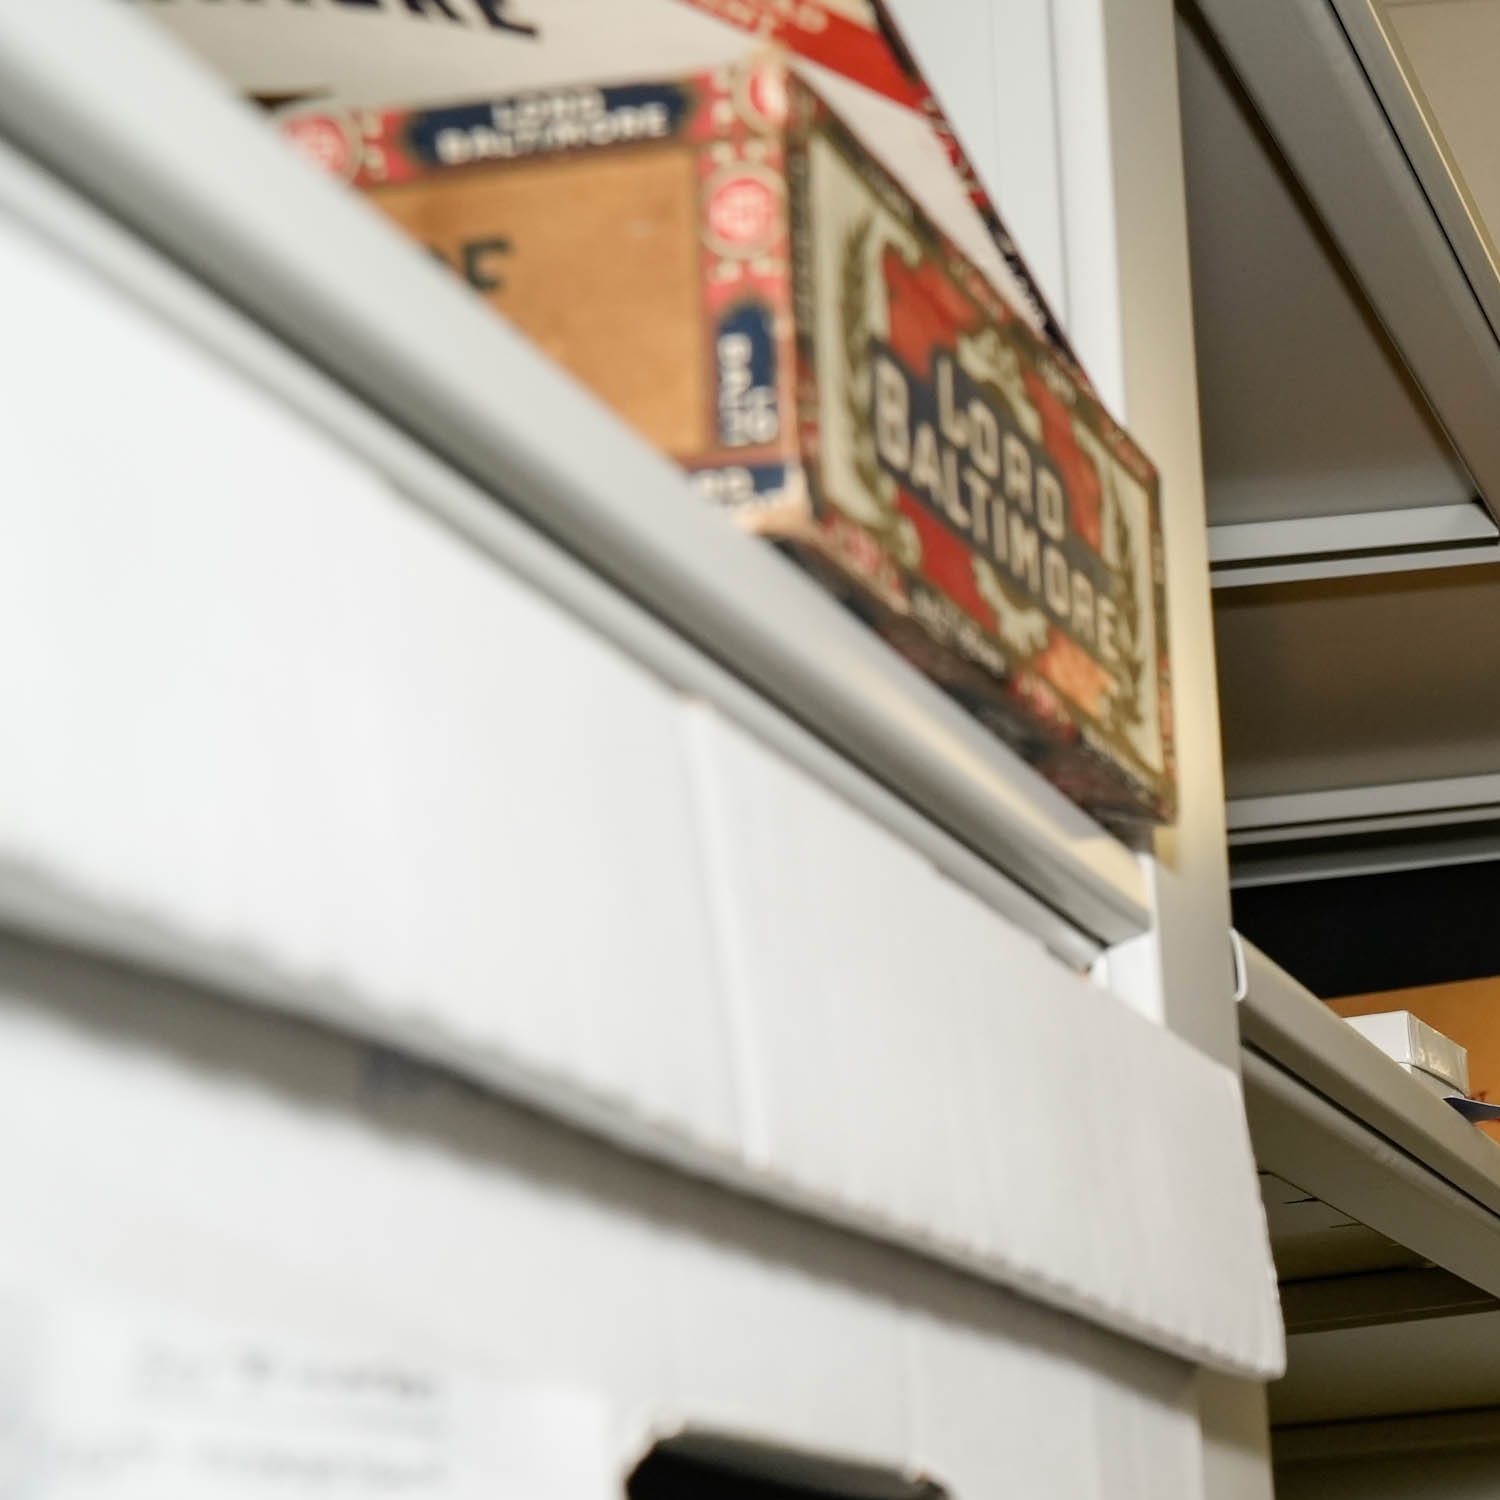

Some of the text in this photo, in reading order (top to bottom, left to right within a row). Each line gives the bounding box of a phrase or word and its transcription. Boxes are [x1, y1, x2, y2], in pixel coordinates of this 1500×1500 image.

[435, 102, 671, 165] BALTIMORE
[491, 87, 606, 132] LORD
[873, 355, 1122, 662] BALTIMORE
[935, 354, 1066, 545] LORD
